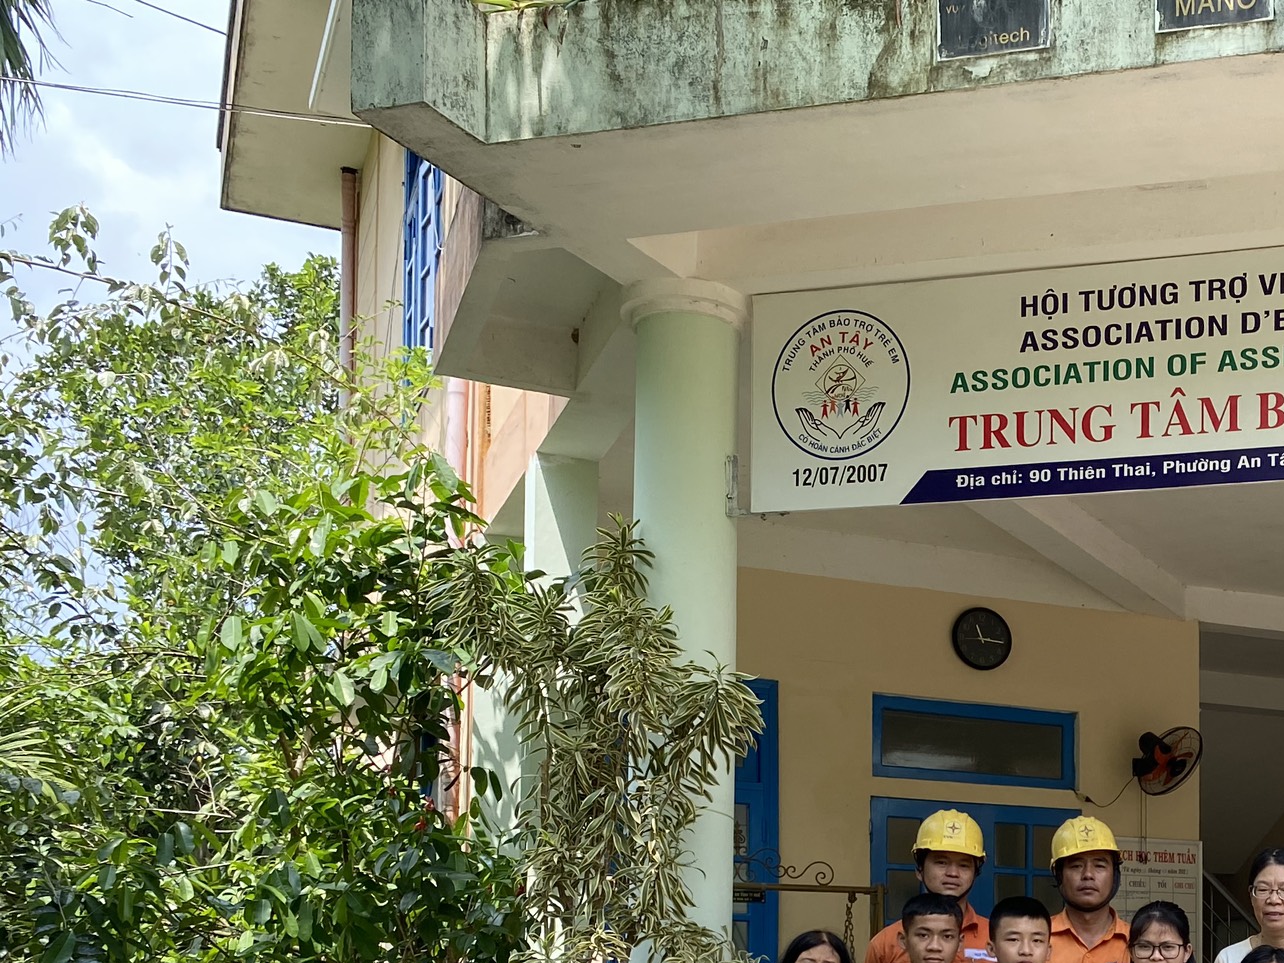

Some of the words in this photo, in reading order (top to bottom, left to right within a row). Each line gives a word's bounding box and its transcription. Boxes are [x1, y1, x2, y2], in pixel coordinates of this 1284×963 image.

[1021, 289, 1068, 320] HỘI
[1079, 283, 1178, 312] TƯƠNG
[1189, 273, 1248, 303] TRỢ
[782, 338, 806, 372] TRUNG
[805, 322, 827, 339] TÂM
[829, 315, 851, 328] BẢO
[853, 319, 875, 333] TRỢ
[874, 328, 893, 348] TRẺ
[888, 348, 900, 364] EM
[809, 334, 832, 357] AN
[839, 330, 873, 351] TÂY
[1020, 314, 1227, 353] ASSOCIATION
[809, 348, 835, 372] THÀNH
[837, 346, 855, 355] PHỐ
[856, 352, 875, 368] HUẾ
[950, 357, 1154, 394] ASSOCIATION
[1167, 352, 1207, 376] OF
[949, 404, 1116, 451] TRUNG
[1130, 387, 1242, 439] TÂM
[798, 433, 808, 443] CÓ
[793, 464, 888, 488] 12/07/2007
[956, 474, 985, 489] Địa
[991, 470, 1023, 485] chỉ:
[1029, 469, 1051, 483] 90
[1057, 466, 1106, 481] Thiên
[1112, 463, 1156, 478] Thai,
[1163, 458, 1231, 474] Phường
[1237, 455, 1261, 469] An
